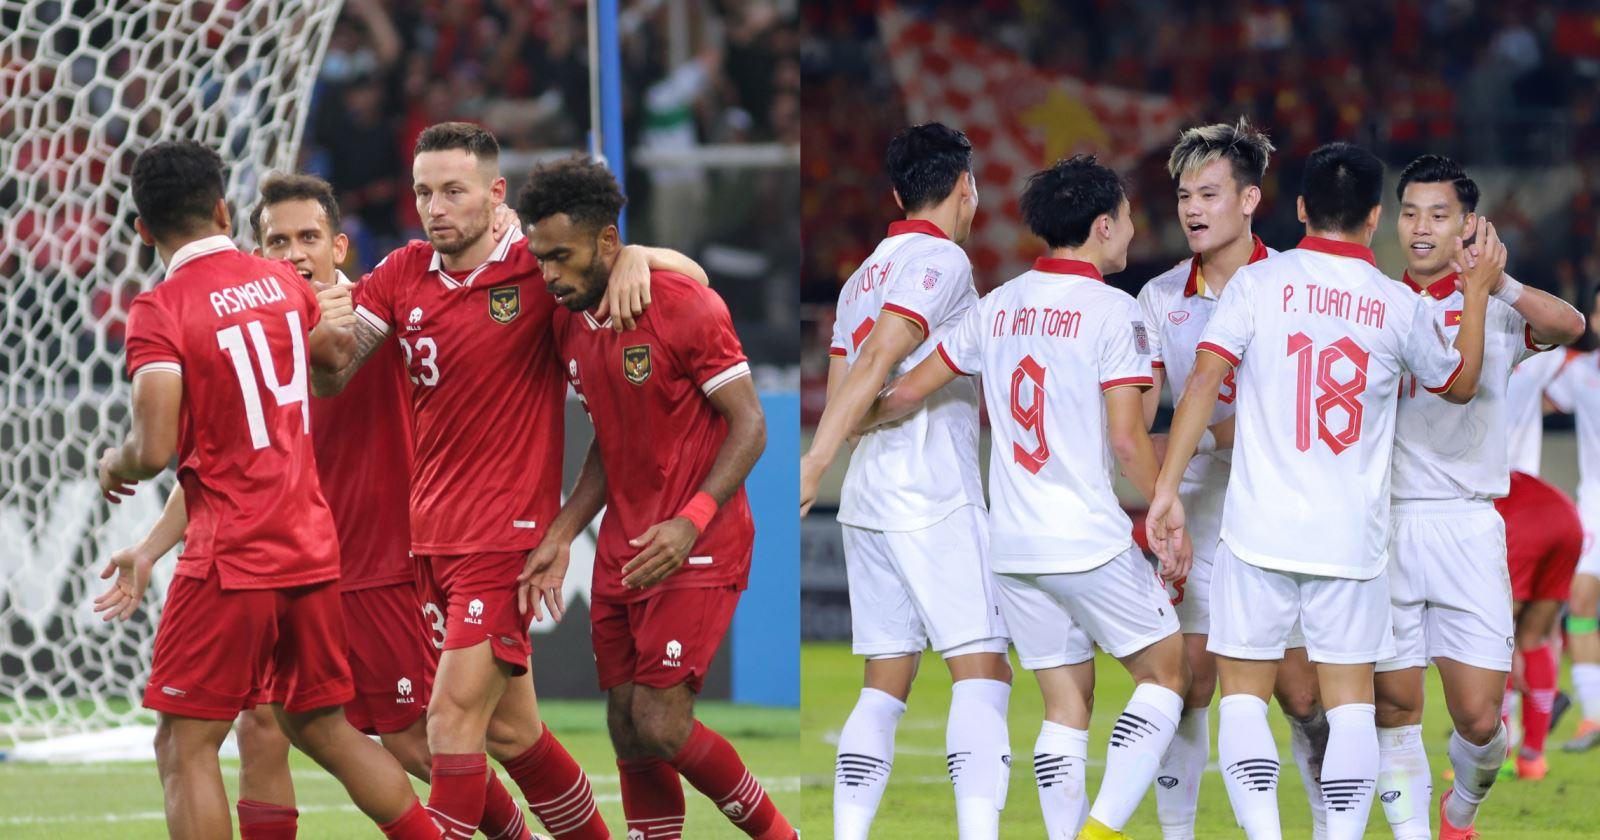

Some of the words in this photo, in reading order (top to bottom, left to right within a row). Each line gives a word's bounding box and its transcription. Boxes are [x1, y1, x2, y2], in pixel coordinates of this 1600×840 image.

[210, 277, 286, 317] ASNAWI
[992, 309, 1006, 338] N.
[1012, 307, 1037, 336] VAN
[1041, 308, 1082, 338] TOAN
[1284, 284, 1297, 312] P.
[1306, 284, 1352, 320] TUAN
[1356, 295, 1385, 329] HAI
[216, 310, 309, 450] 14
[1010, 354, 1051, 475] 9
[1287, 331, 1369, 455] 18
